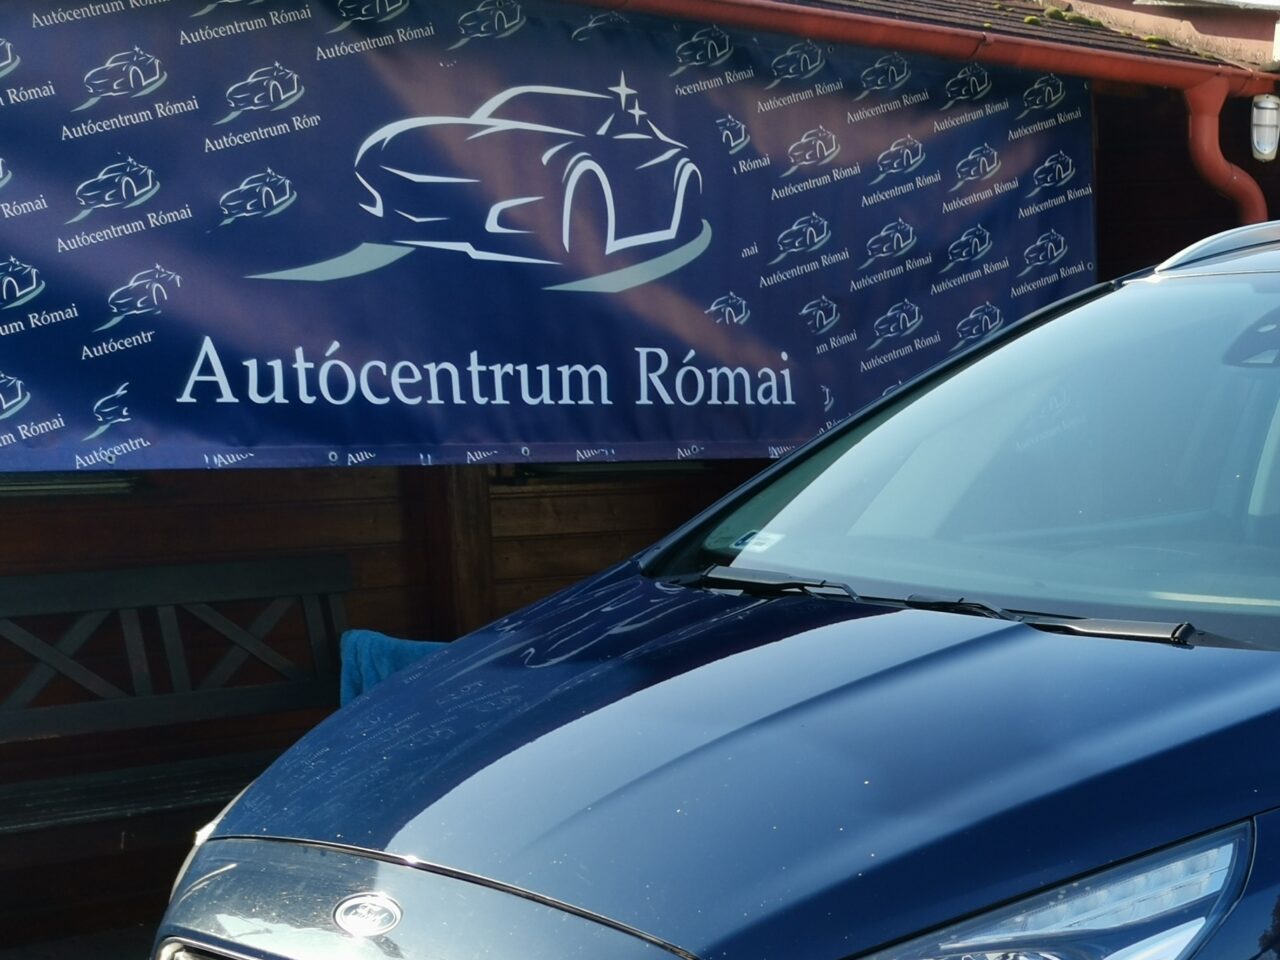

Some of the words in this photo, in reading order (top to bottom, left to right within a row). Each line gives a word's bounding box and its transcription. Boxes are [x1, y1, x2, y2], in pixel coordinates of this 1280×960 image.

[32, 0, 125, 28] Autócentrum
[179, 16, 267, 45] Autócentrum
[270, 5, 312, 25] Római
[316, 35, 395, 61] Autócentrum
[397, 22, 435, 43] Római
[6, 81, 56, 104] Római
[725, 65, 754, 84] Római
[757, 88, 814, 113] Autócentrum
[815, 77, 843, 96] Római
[847, 101, 901, 124] Autócentrum
[901, 88, 930, 106] Római
[61, 109, 153, 140] Autócentrum
[155, 96, 199, 119] Római
[933, 109, 984, 133] Autócentrum
[984, 98, 1010, 115] Római
[1008, 118, 1057, 141] Autócentrum
[1056, 107, 1082, 124] Római
[204, 122, 290, 152] Autócentrum
[738, 153, 771, 174] Római
[771, 174, 831, 200] Autócentrum
[832, 162, 861, 182] Római
[1, 194, 48, 218] Római
[861, 182, 914, 208] Autócentrum
[915, 169, 941, 189] Római
[942, 190, 993, 214] Autócentrum
[993, 178, 1019, 198] Római
[1018, 196, 1067, 219] Autócentrum
[1066, 184, 1093, 202] Római
[57, 220, 146, 253] Autócentrum
[147, 204, 193, 228] Római
[760, 261, 820, 288] Autócentrum
[820, 247, 850, 267] Római
[849, 267, 904, 292] Autócentrum
[905, 252, 932, 273] Római
[930, 271, 982, 295] Autócentrum
[983, 256, 1010, 276] Római
[1010, 273, 1059, 298] Autócentrum
[1059, 260, 1085, 280] Római
[28, 303, 79, 329] Római
[81, 331, 155, 360] Autócentr
[829, 328, 857, 349] Római
[859, 345, 913, 372] Autócentrum
[914, 332, 941, 351] Római
[176, 335, 613, 405] Autócentrum
[634, 346, 796, 406] Római
[17, 413, 65, 440] Római
